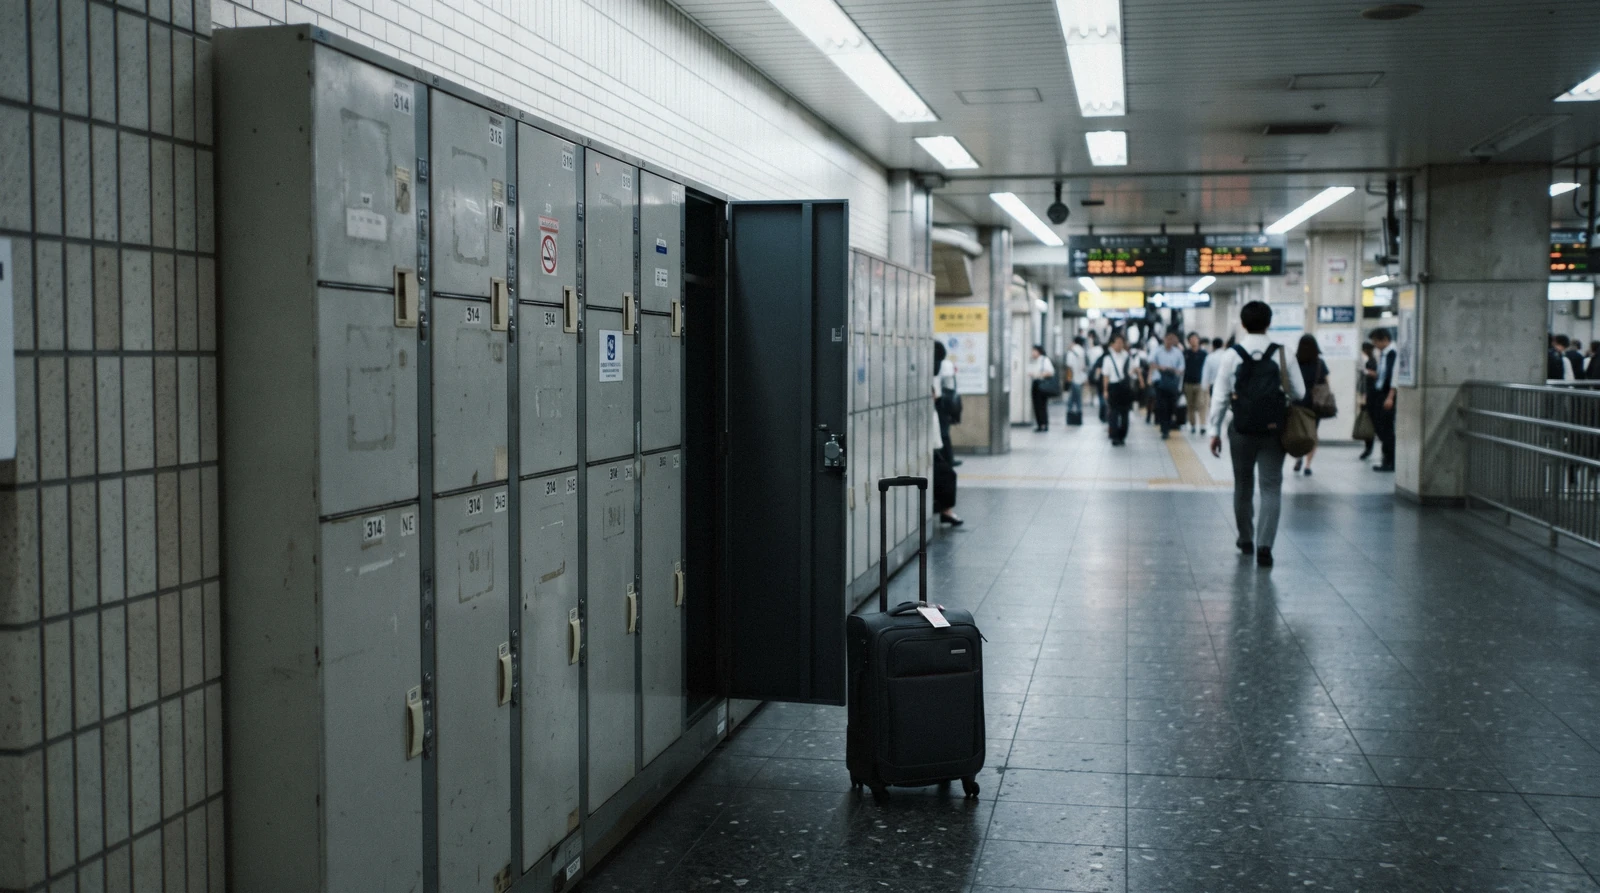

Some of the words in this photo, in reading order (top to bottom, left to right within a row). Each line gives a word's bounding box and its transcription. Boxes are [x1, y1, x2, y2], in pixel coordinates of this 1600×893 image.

[394, 93, 409, 112] 314
[467, 307, 479, 321] 314
[545, 312, 555, 325] 314
[546, 480, 556, 494] 314
[469, 497, 481, 513] 314
[367, 519, 382, 537] 314
[402, 515, 414, 532] NE
